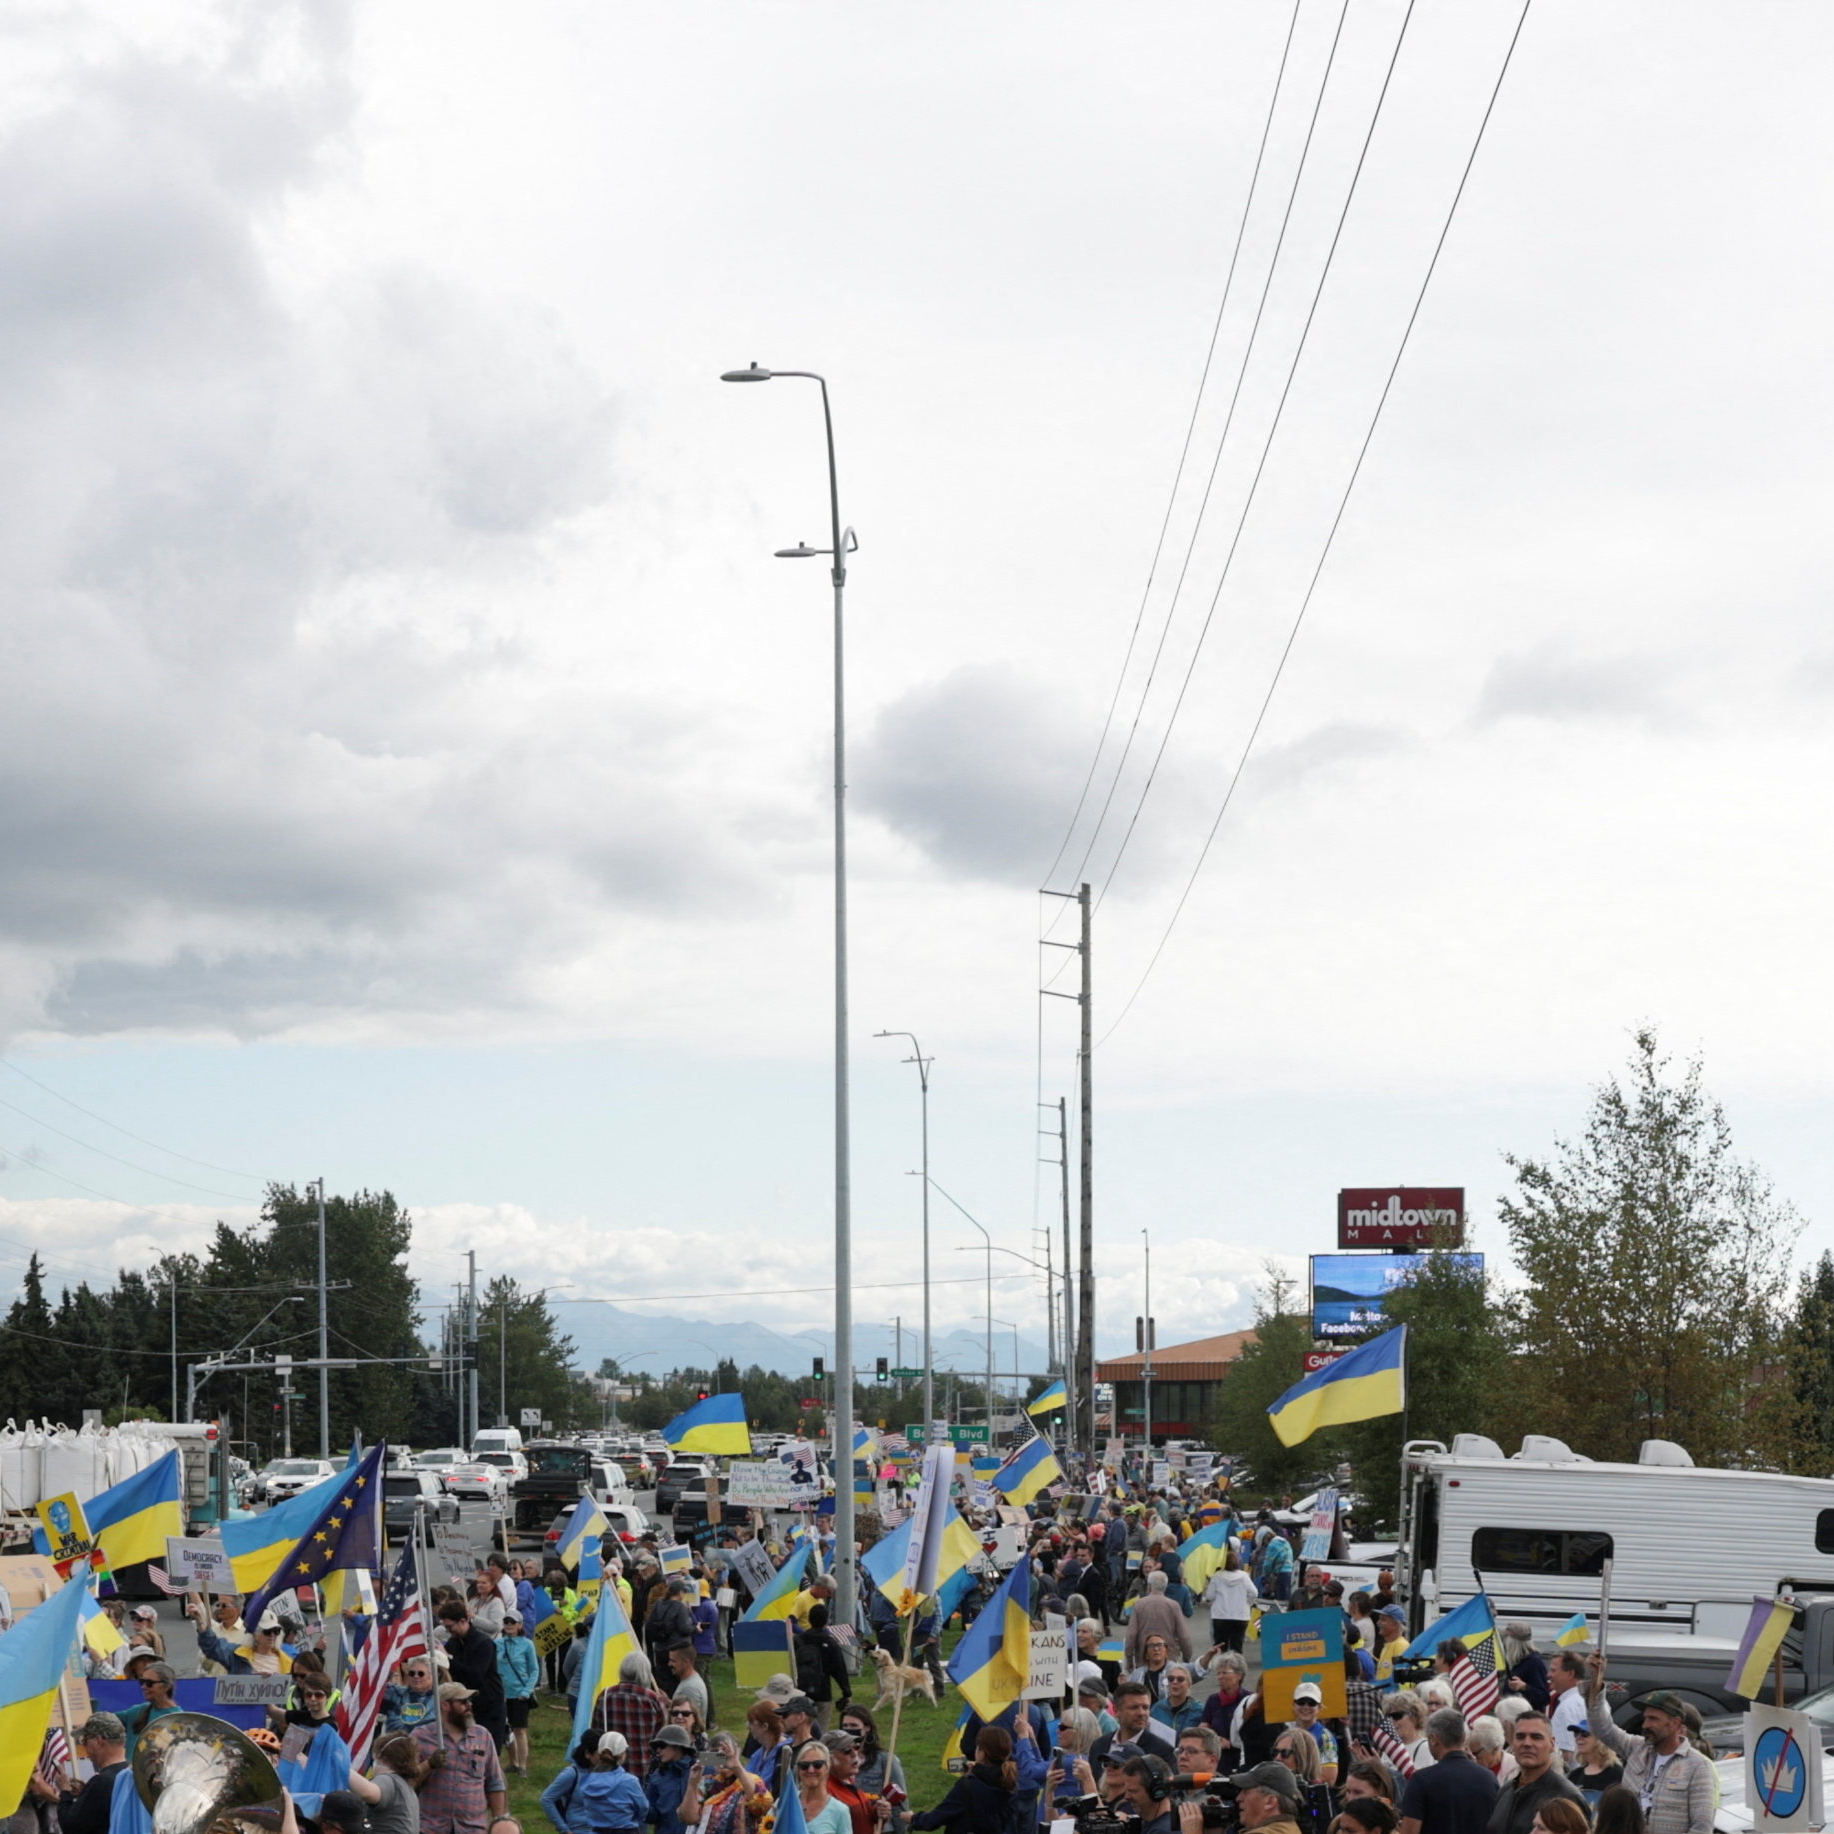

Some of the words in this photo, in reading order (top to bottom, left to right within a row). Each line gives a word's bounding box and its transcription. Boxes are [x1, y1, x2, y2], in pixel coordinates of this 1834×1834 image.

[1347, 1195, 1457, 1226] midtown
[1347, 1229, 1456, 1239] MAL
[959, 1428, 984, 1440] Blvd
[59, 1532, 79, 1548] WAR
[983, 1530, 996, 1541] I
[183, 1550, 223, 1564] DEMOCRACY
[1031, 1634, 1065, 1649] KANS
[1291, 1632, 1318, 1641] STAND
[1035, 1656, 1058, 1666] WITH
